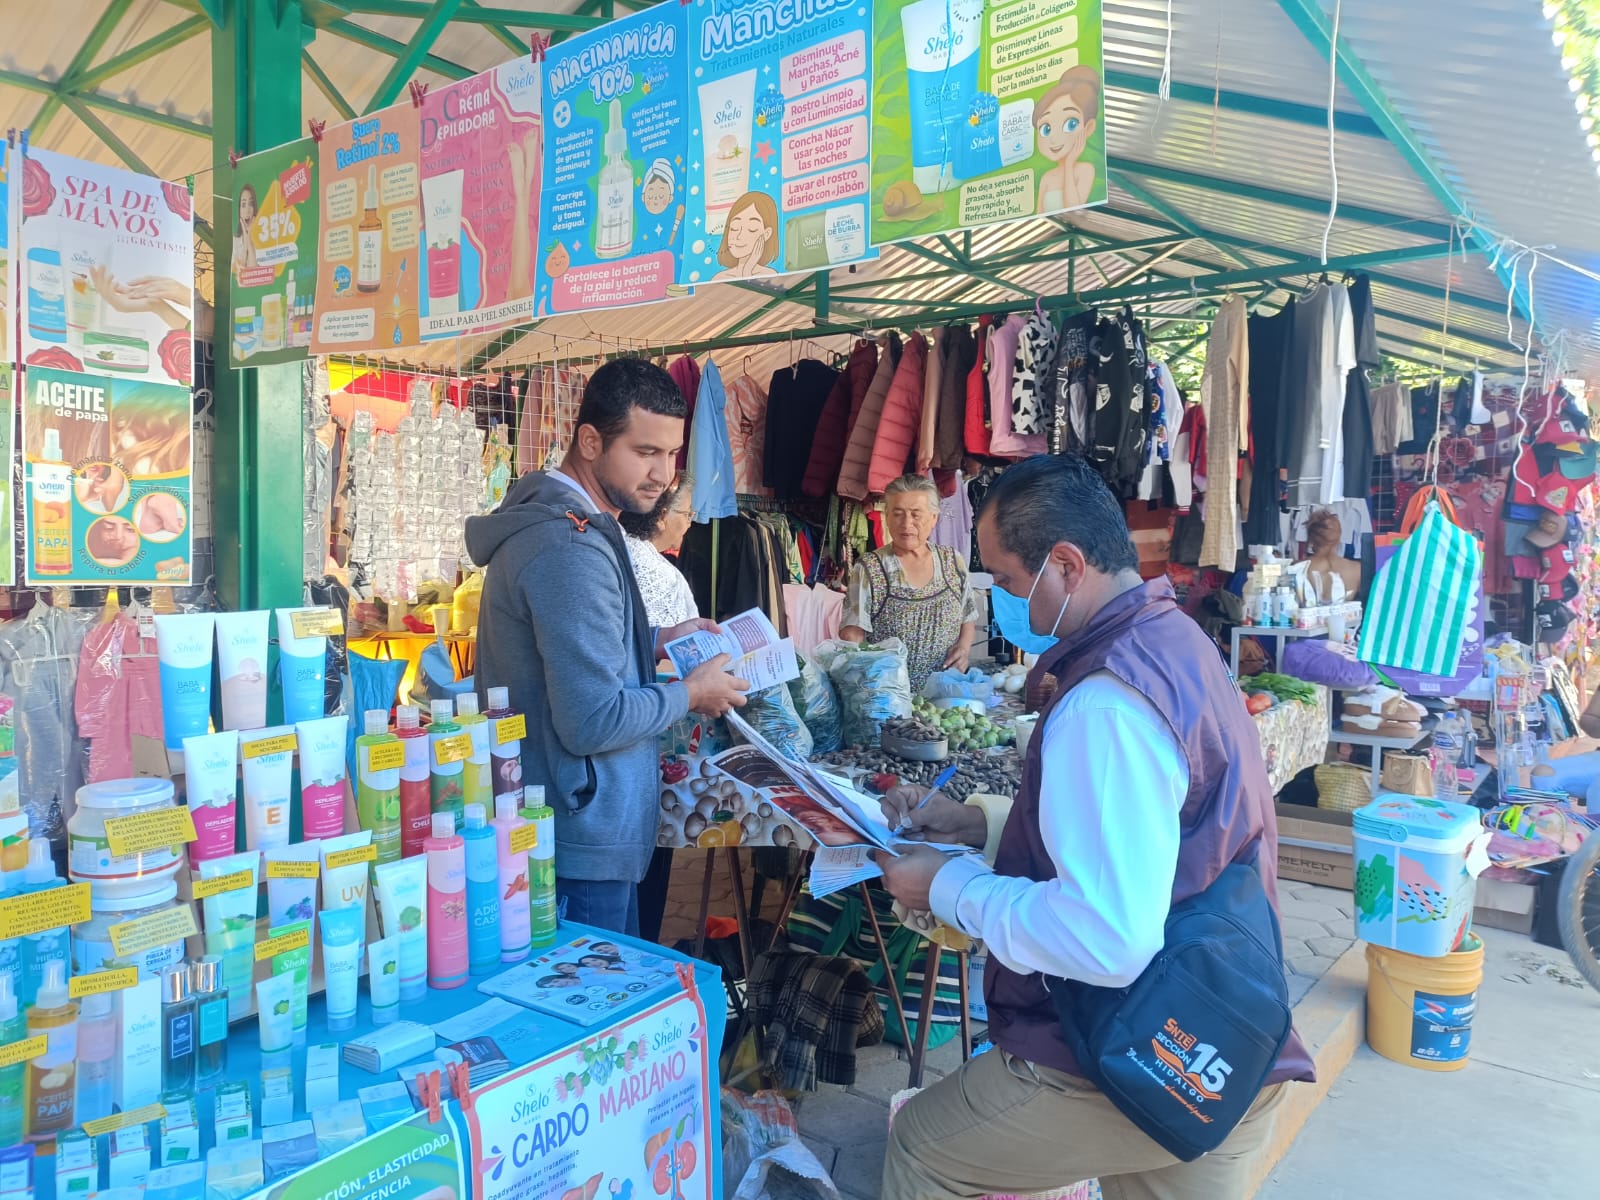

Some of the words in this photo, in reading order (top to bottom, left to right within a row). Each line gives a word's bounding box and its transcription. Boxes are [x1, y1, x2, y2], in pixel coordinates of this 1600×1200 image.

[996, 6, 1027, 23] Estimula
[1028, 2, 1036, 11] la
[996, 13, 1034, 33] Producción
[710, 42, 785, 73] Tratamientos
[787, 16, 845, 48] Naturales
[792, 41, 845, 68] Disminuye
[996, 34, 1037, 54] Disminuye
[788, 59, 833, 81] Manchas,
[834, 47, 860, 66] Acné
[997, 54, 1006, 64] de
[590, 63, 633, 103] 10%
[801, 82, 808, 92] y
[809, 68, 840, 86] Paños
[997, 71, 1014, 84] Usar
[1015, 65, 1034, 80] todos
[1036, 62, 1047, 73] los
[951, 82, 961, 91] DE
[997, 85, 1009, 97] por
[1010, 81, 1018, 91] la
[1019, 73, 1047, 88] mañana
[662, 99, 677, 110] tono
[791, 99, 820, 116] Rostro
[822, 88, 854, 107] Limpio
[784, 121, 790, 131] y
[790, 116, 806, 128] con
[808, 96, 865, 122] Luminosidad
[1002, 116, 1023, 129] BABA
[352, 118, 381, 140] Suero
[420, 107, 497, 150] DEPILADORA
[587, 127, 593, 135] la
[788, 133, 823, 150] Concha
[824, 123, 854, 140] Nácar
[335, 133, 380, 171] Retinol
[381, 132, 401, 155] 2%
[793, 148, 814, 160] usar
[815, 141, 834, 156] solo
[836, 136, 853, 153] por
[556, 156, 564, 164] de
[799, 159, 812, 171] las
[814, 149, 848, 167] noches
[555, 173, 575, 184] poros
[788, 180, 814, 195] Lavar
[816, 175, 826, 187] el
[827, 169, 858, 185] rostro
[967, 184, 977, 194] No
[61, 175, 112, 205] SPA
[120, 189, 159, 215] DE
[556, 190, 584, 202] Corrige
[787, 193, 813, 207] diario
[815, 189, 831, 201] con
[836, 181, 864, 197] Jabón
[966, 192, 994, 206] grasosa,
[996, 185, 1025, 199] absorbe
[552, 200, 587, 213] manchas
[558, 214, 563, 222] y
[564, 210, 581, 219] tono
[964, 210, 997, 222] Refresca
[998, 207, 1006, 216] la
[1007, 203, 1022, 215] Piel.
[965, 202, 981, 214] muy
[1006, 198, 1011, 206] y
[58, 198, 162, 238] MANOS
[257, 210, 296, 243] 35%
[552, 218, 586, 232] desigual.
[832, 218, 855, 229] LECHE
[827, 228, 837, 236] DE
[838, 223, 861, 235] BURRA
[563, 270, 610, 284] Fortalece
[612, 266, 622, 277] la
[623, 260, 660, 275] barrera
[570, 283, 582, 294] de
[584, 281, 594, 292] la
[595, 279, 615, 292] piel
[617, 280, 622, 289] y
[624, 273, 657, 286] reduce
[582, 287, 645, 304] inflamación.
[430, 317, 455, 330] IDEAL
[457, 313, 480, 326] PARA
[481, 310, 498, 322] PIEL
[498, 301, 533, 318] SENSIBLE
[35, 379, 105, 413] ACEITE
[54, 406, 72, 418] de
[75, 411, 109, 422] papa
[106, 565, 117, 576] tu
[266, 807, 281, 828] E
[341, 884, 366, 903] UV
[1164, 1017, 1197, 1051] SNTE
[1187, 1042, 1233, 1093] 15
[1154, 1059, 1205, 1103] HIDALGO
[512, 1103, 590, 1169] CARDO
[599, 1051, 686, 1124] MARIANO
[368, 1133, 450, 1185] ELASTICIDAD
[534, 1169, 542, 1180] en
